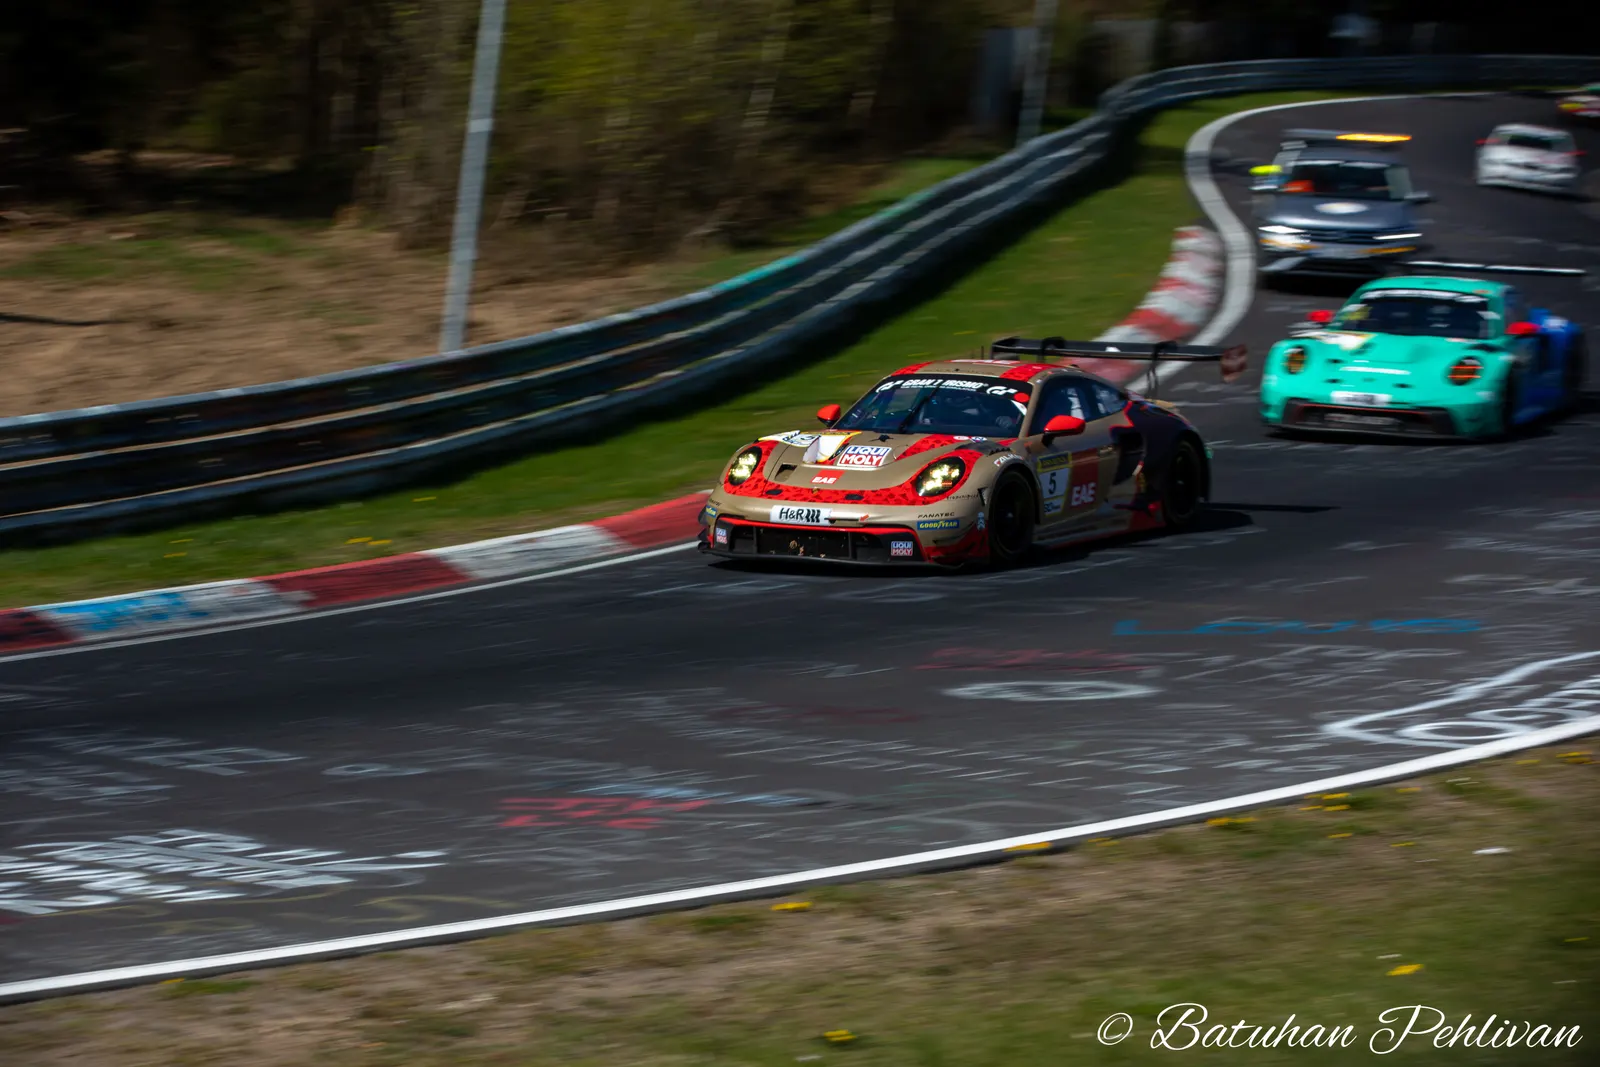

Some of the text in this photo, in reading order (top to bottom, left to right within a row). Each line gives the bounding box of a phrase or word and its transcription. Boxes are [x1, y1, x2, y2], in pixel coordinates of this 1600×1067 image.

[847, 446, 888, 456] LIQUI
[841, 454, 883, 466] MOLY
[812, 476, 837, 484] EAE
[1048, 471, 1057, 495] 5
[1071, 482, 1097, 506] EAE
[779, 507, 804, 521] H&R
[919, 520, 958, 529] GOODYEAR
[892, 541, 912, 549] LIQUI
[892, 548, 913, 556] MOLY
